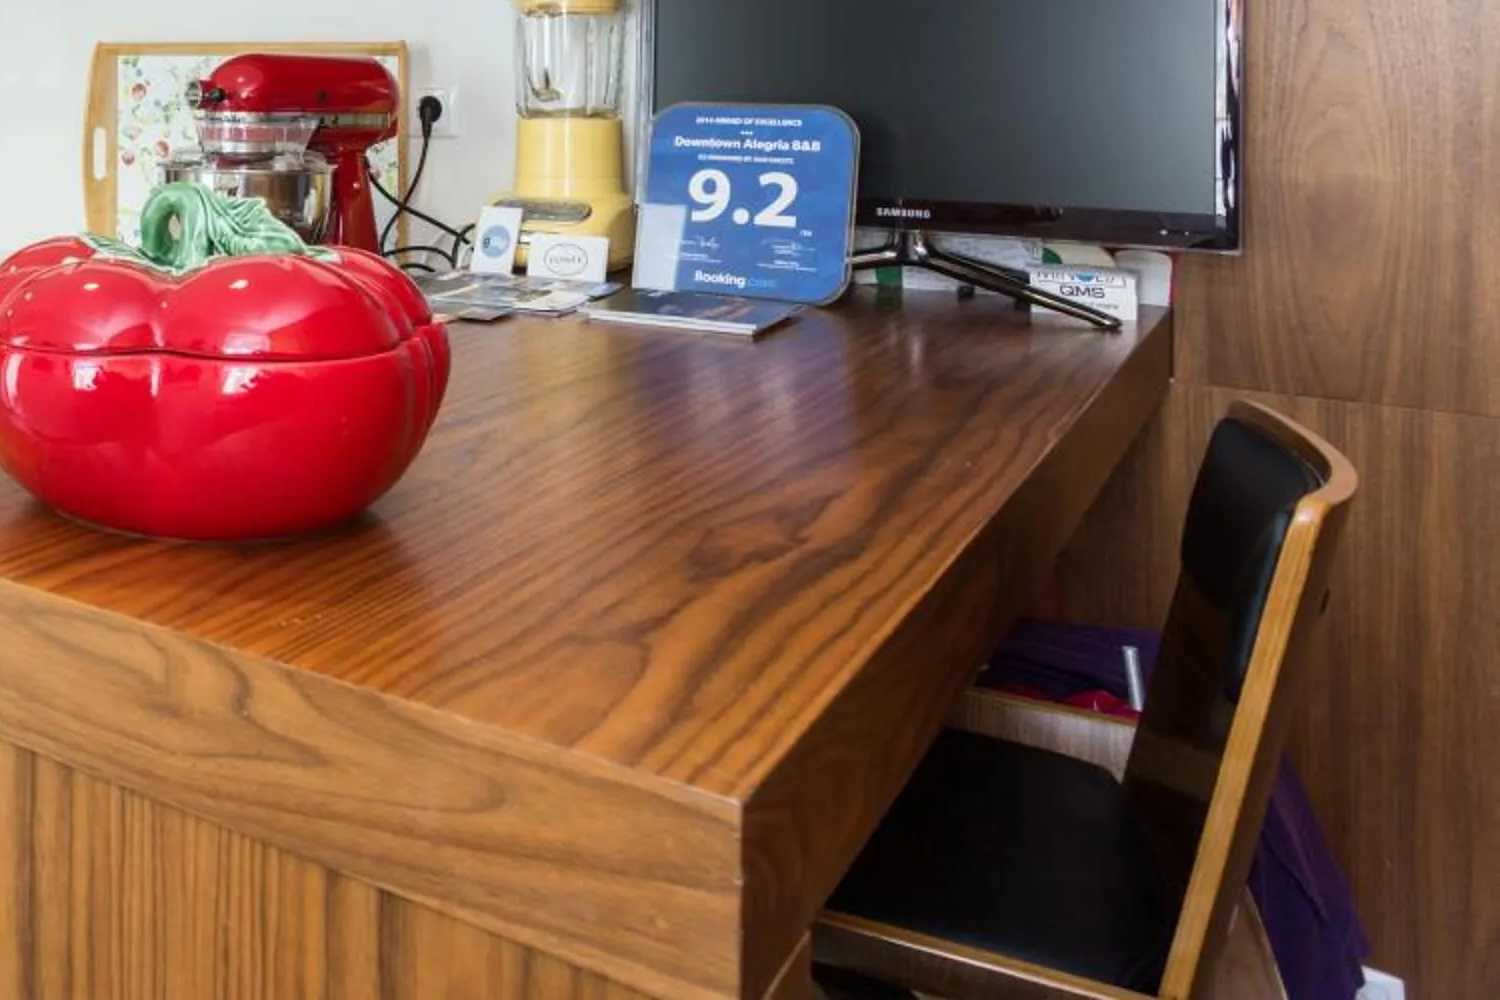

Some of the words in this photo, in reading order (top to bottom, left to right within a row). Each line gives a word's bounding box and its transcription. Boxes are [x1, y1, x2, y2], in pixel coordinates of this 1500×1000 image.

[674, 135, 740, 149] Downtown
[743, 138, 789, 152] Alegria
[688, 168, 798, 228] 9.2
[876, 207, 931, 219] SAMSUNG
[1060, 283, 1105, 299] QMS
